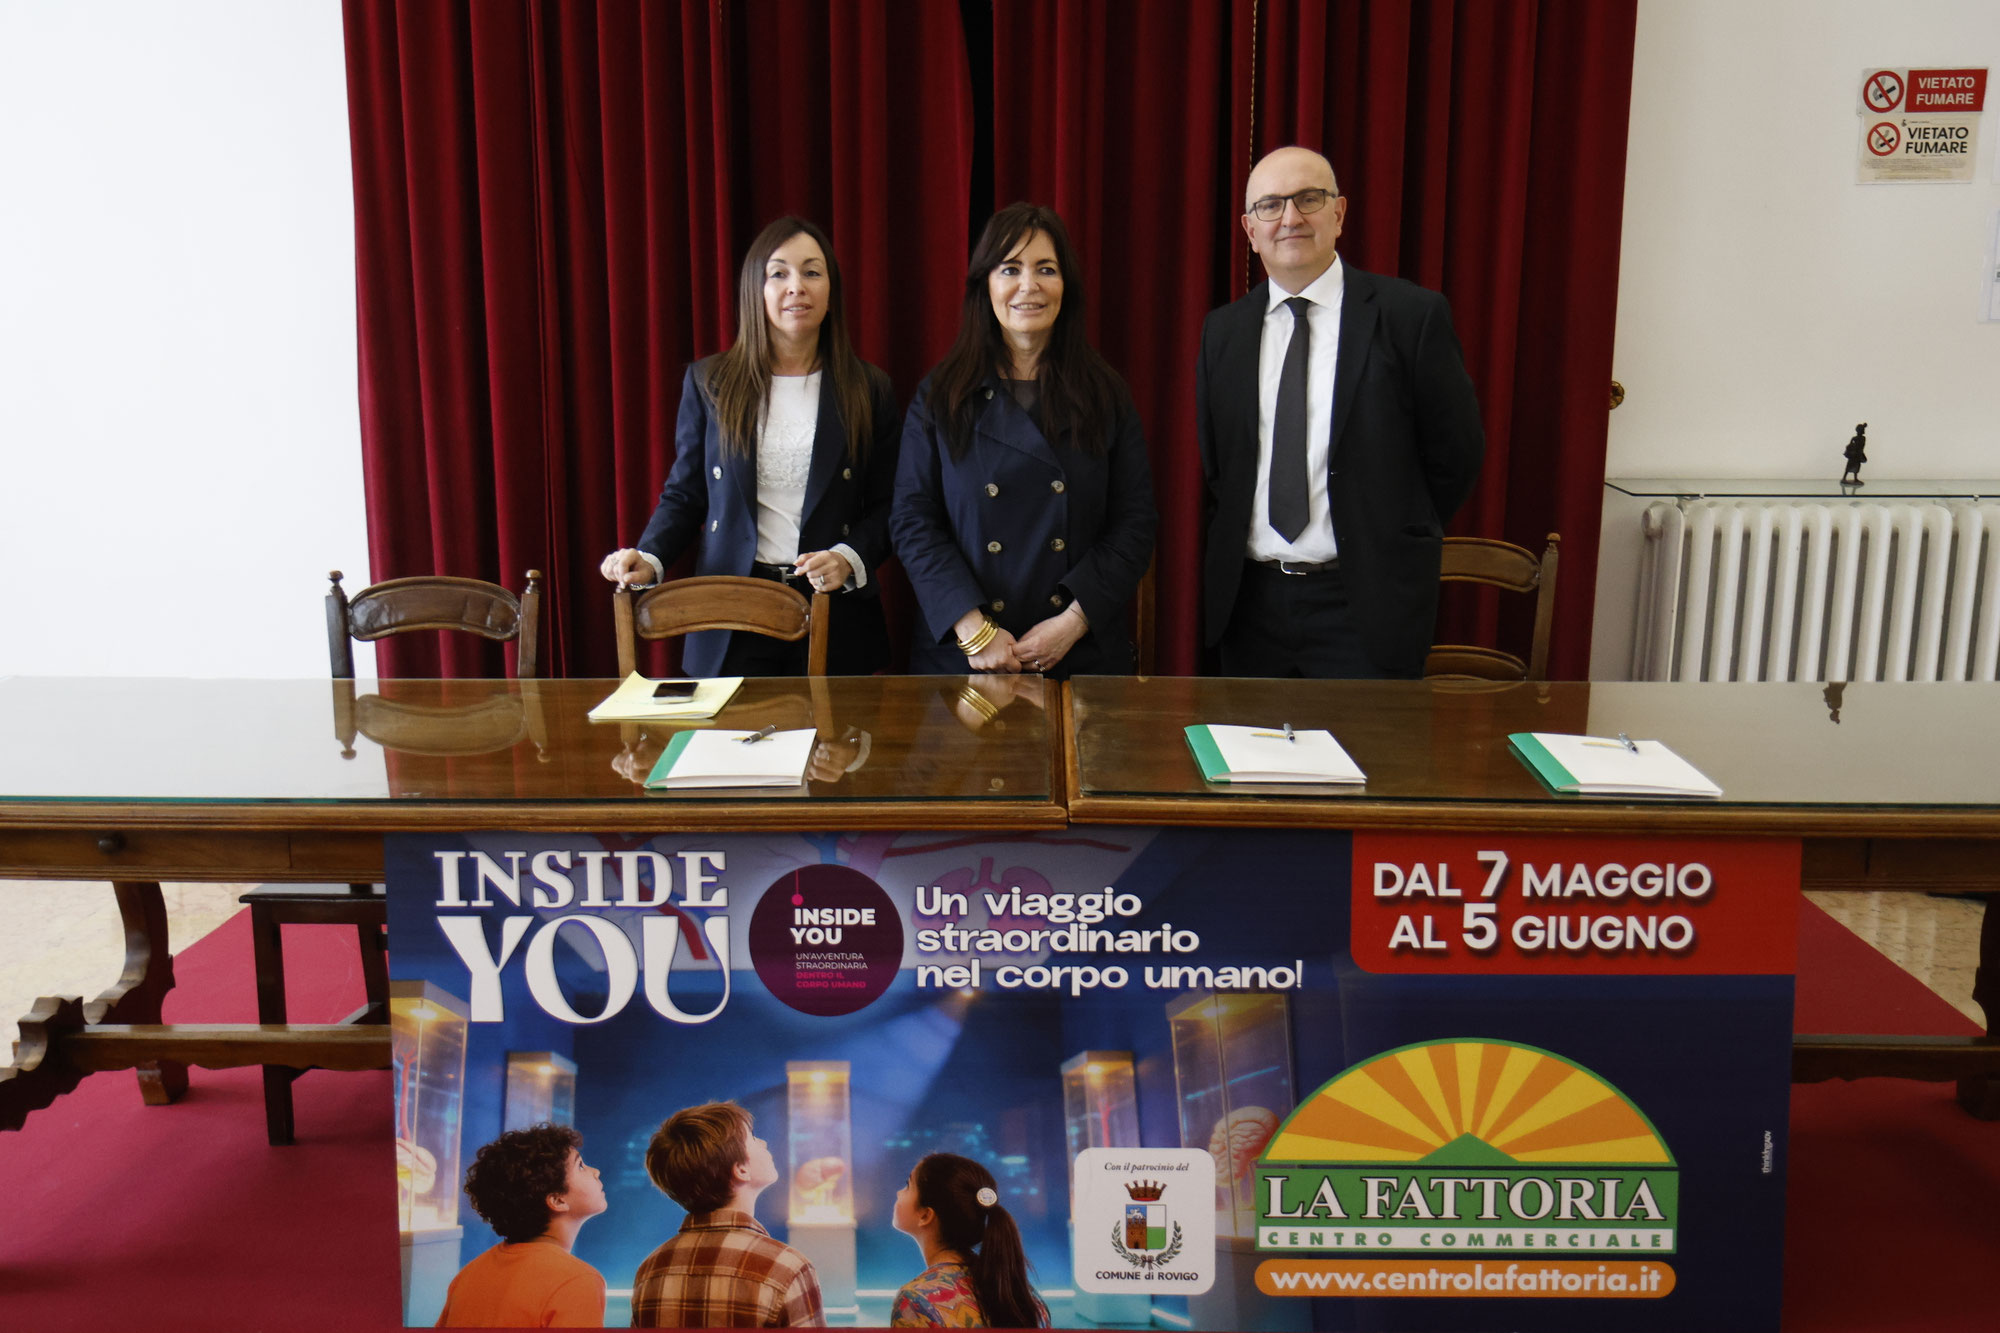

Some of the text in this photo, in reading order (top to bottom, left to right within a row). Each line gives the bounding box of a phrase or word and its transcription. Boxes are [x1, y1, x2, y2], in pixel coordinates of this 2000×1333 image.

[1918, 77, 1975, 89] VIETATO
[1916, 93, 1974, 105] FUMARE
[1908, 127, 1969, 139] VIETATO
[1905, 142, 1968, 154] FUMARE
[434, 850, 729, 908] INSIDE
[1373, 850, 1712, 897] DAL 7 MAGGIO
[916, 886, 1142, 923] Un viaggio
[794, 908, 876, 926] INSIDE
[1388, 903, 1694, 949] AL 5 GIUGNO
[790, 927, 842, 945] YOU
[917, 923, 1200, 953] straordinario
[796, 952, 864, 961] UN'AVVENTURA
[796, 961, 868, 970] STRAORDINARIA
[437, 914, 731, 1024] YOU
[917, 959, 1303, 996] nel corpo umano!
[1104, 1162, 1190, 1173] Con il patrocinio del
[1263, 1176, 1667, 1222] LA FATTORIA
[1267, 1231, 1661, 1248] CENTRO COMMERCIALE
[1095, 1271, 1199, 1281] COMUNE di ROVIGO
[1270, 1264, 1661, 1293] www.centrolafattoria.it
